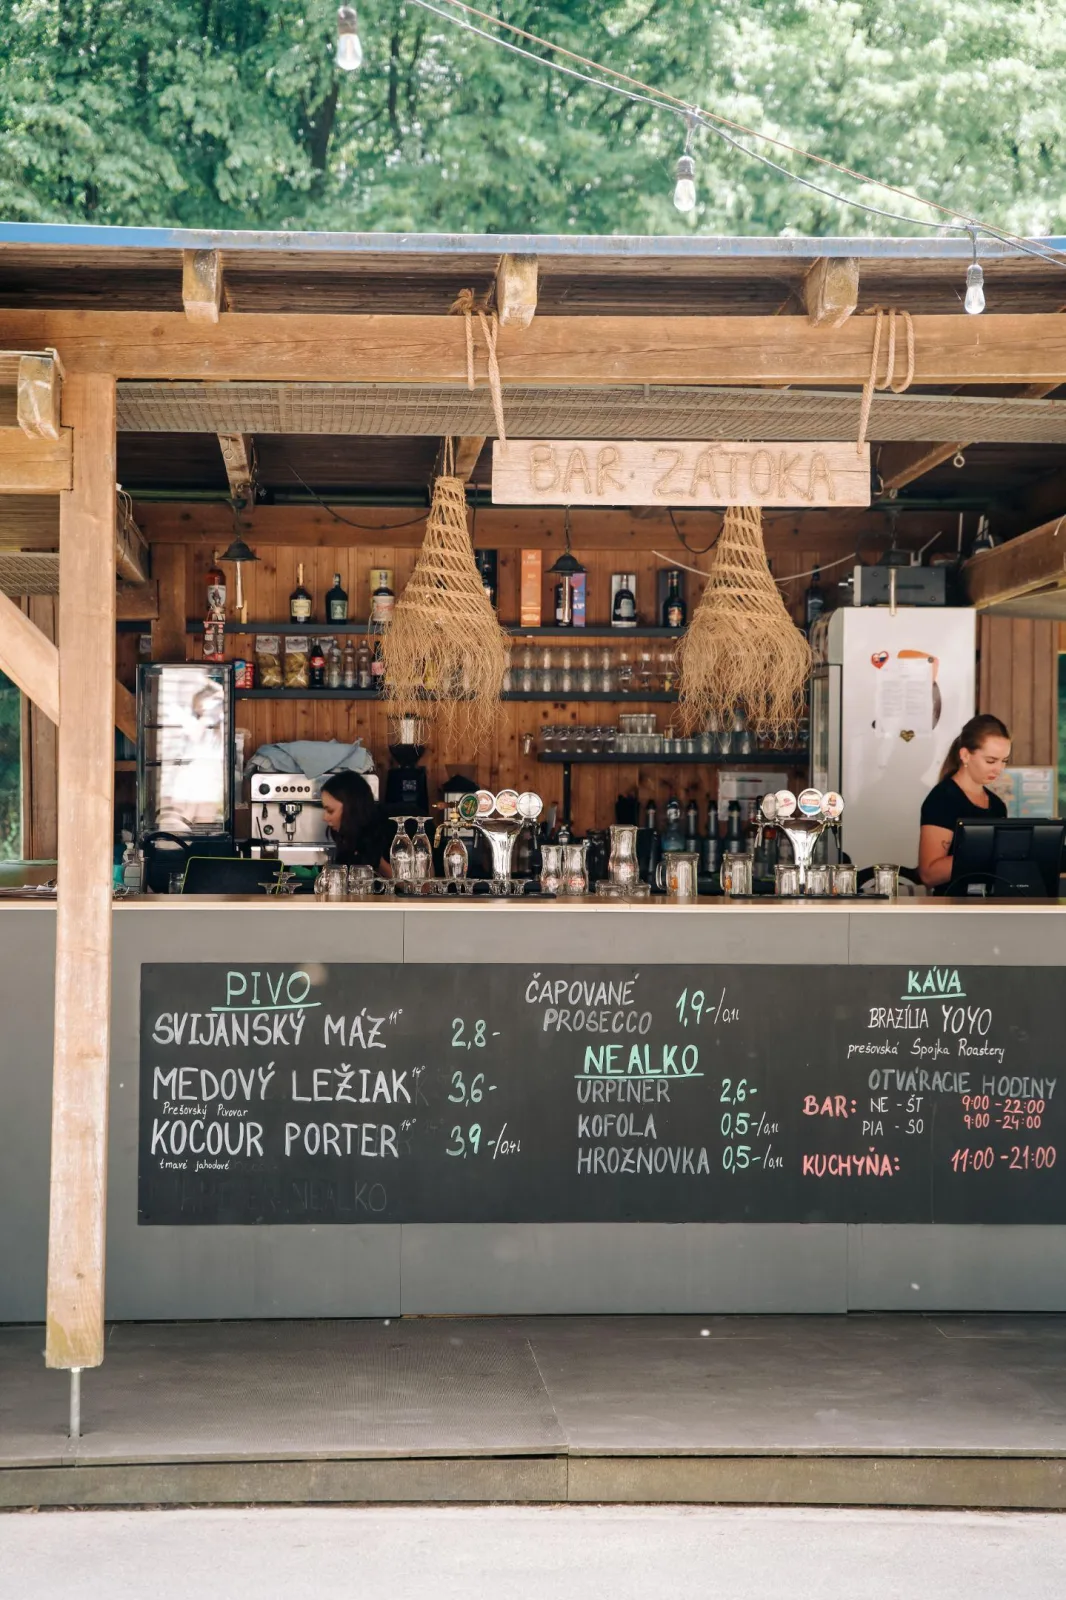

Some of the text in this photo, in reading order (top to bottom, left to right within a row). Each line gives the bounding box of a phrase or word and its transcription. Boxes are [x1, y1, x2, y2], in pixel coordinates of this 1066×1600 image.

[529, 444, 625, 497] BAR
[226, 971, 311, 1005] PIVO
[525, 972, 640, 1007] ČAPOVANÉ
[907, 966, 962, 993] KÁVA
[152, 1009, 306, 1047] SVIJANSKÝ
[324, 1008, 387, 1049] MÁZ
[542, 1008, 653, 1035] PROSECCO
[867, 1004, 993, 1036] BRAZÍLIA YOYO
[583, 1044, 699, 1075] NEALKO
[910, 1037, 951, 1061] Spojka
[957, 1037, 1006, 1064] Roastery
[152, 1061, 276, 1102] MEDOVÝ
[291, 1063, 412, 1104] LEŽIAK
[576, 1079, 671, 1104] URPINER
[868, 1066, 1058, 1100] OTVÁRACIE HODINY
[162, 1101, 249, 1120] Prešovský Pivovar
[802, 1095, 858, 1119] BAR:
[870, 1096, 889, 1113] NE
[150, 1117, 264, 1157] KOCOUR
[284, 1121, 399, 1159] PORTER
[577, 1112, 658, 1140] KOFOLA
[861, 1119, 884, 1137] PIA
[905, 1118, 925, 1135] SO
[159, 1157, 189, 1169] tmavé
[194, 1158, 231, 1173] jahodové
[577, 1146, 711, 1175] HROZNOVKA
[802, 1146, 901, 1177] KUCHYŇA:
